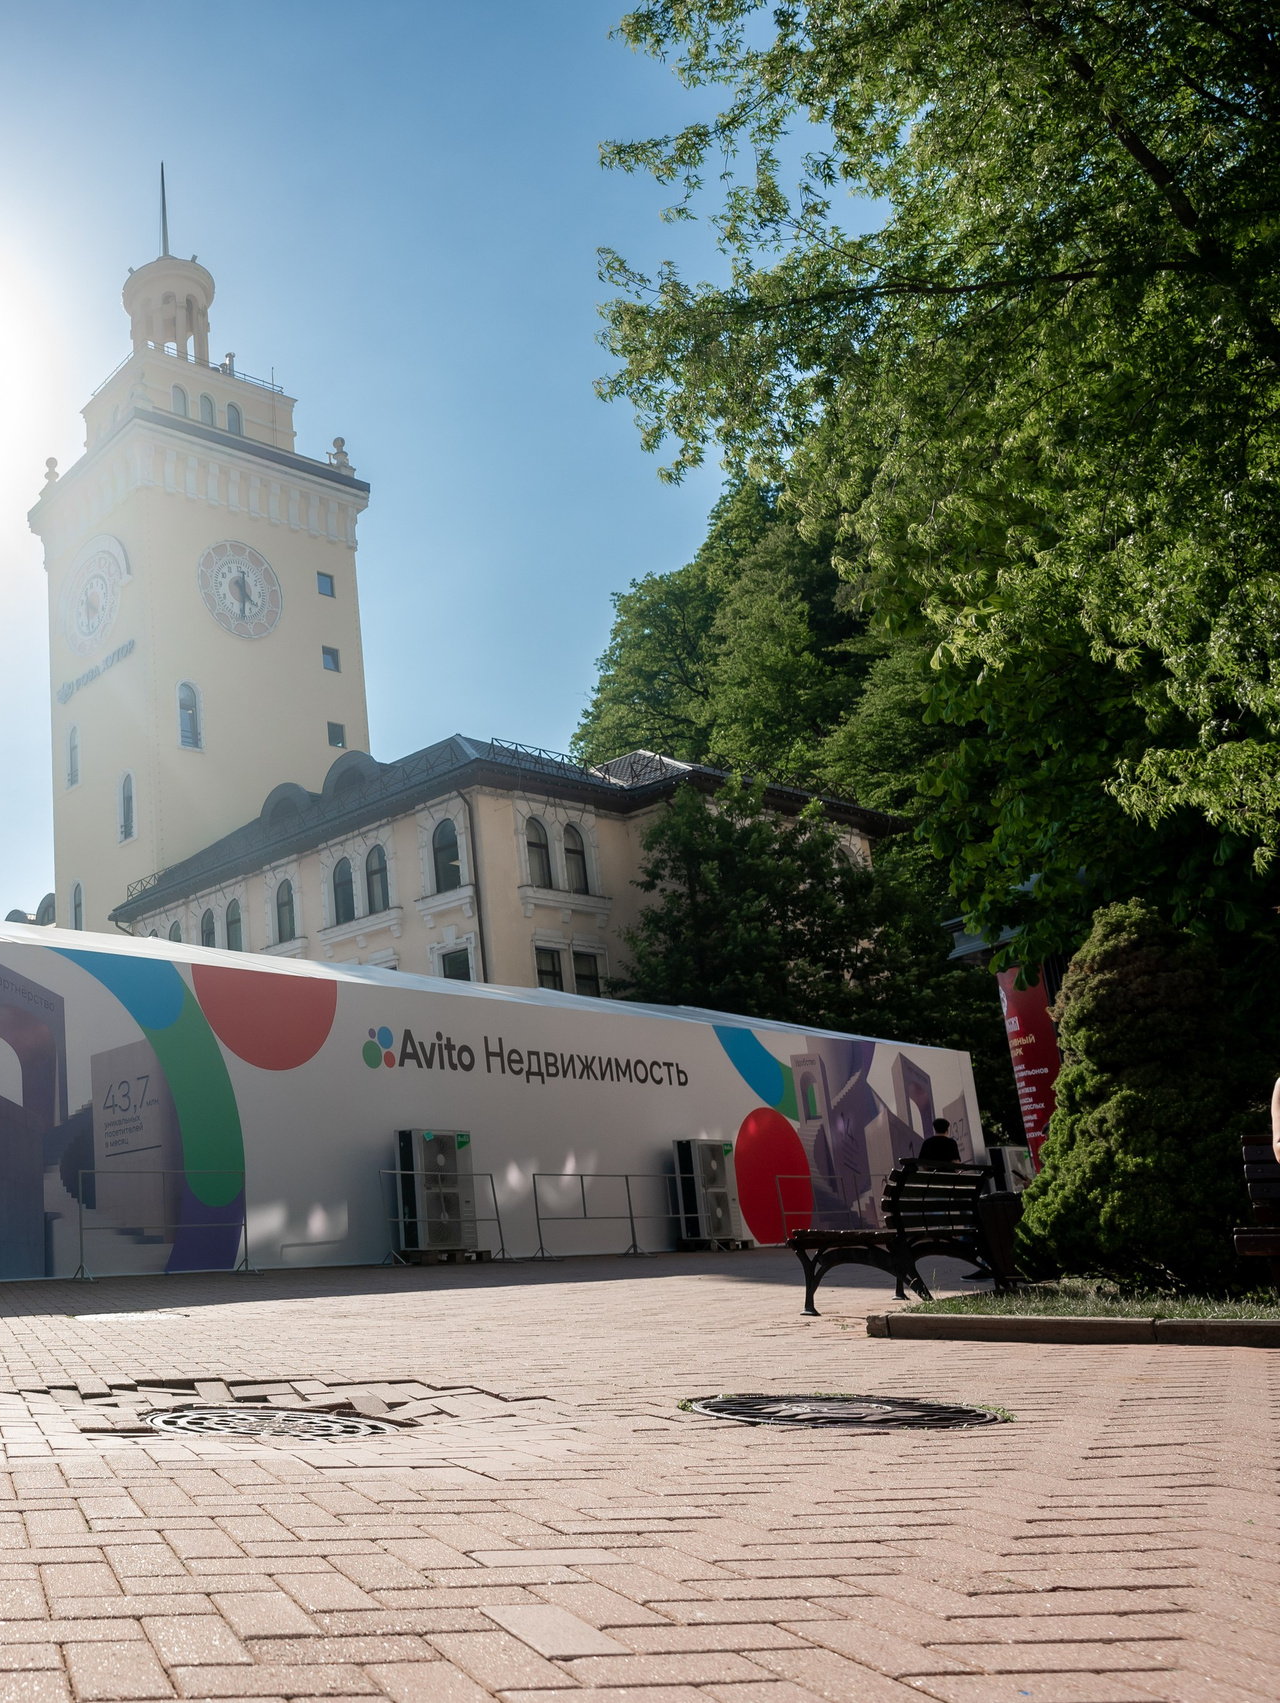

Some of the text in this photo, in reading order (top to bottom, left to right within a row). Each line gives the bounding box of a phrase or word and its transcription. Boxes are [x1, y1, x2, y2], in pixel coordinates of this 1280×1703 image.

[398, 1029, 689, 1087] Avito Недвижимость
[103, 1075, 150, 1115] 43,7
